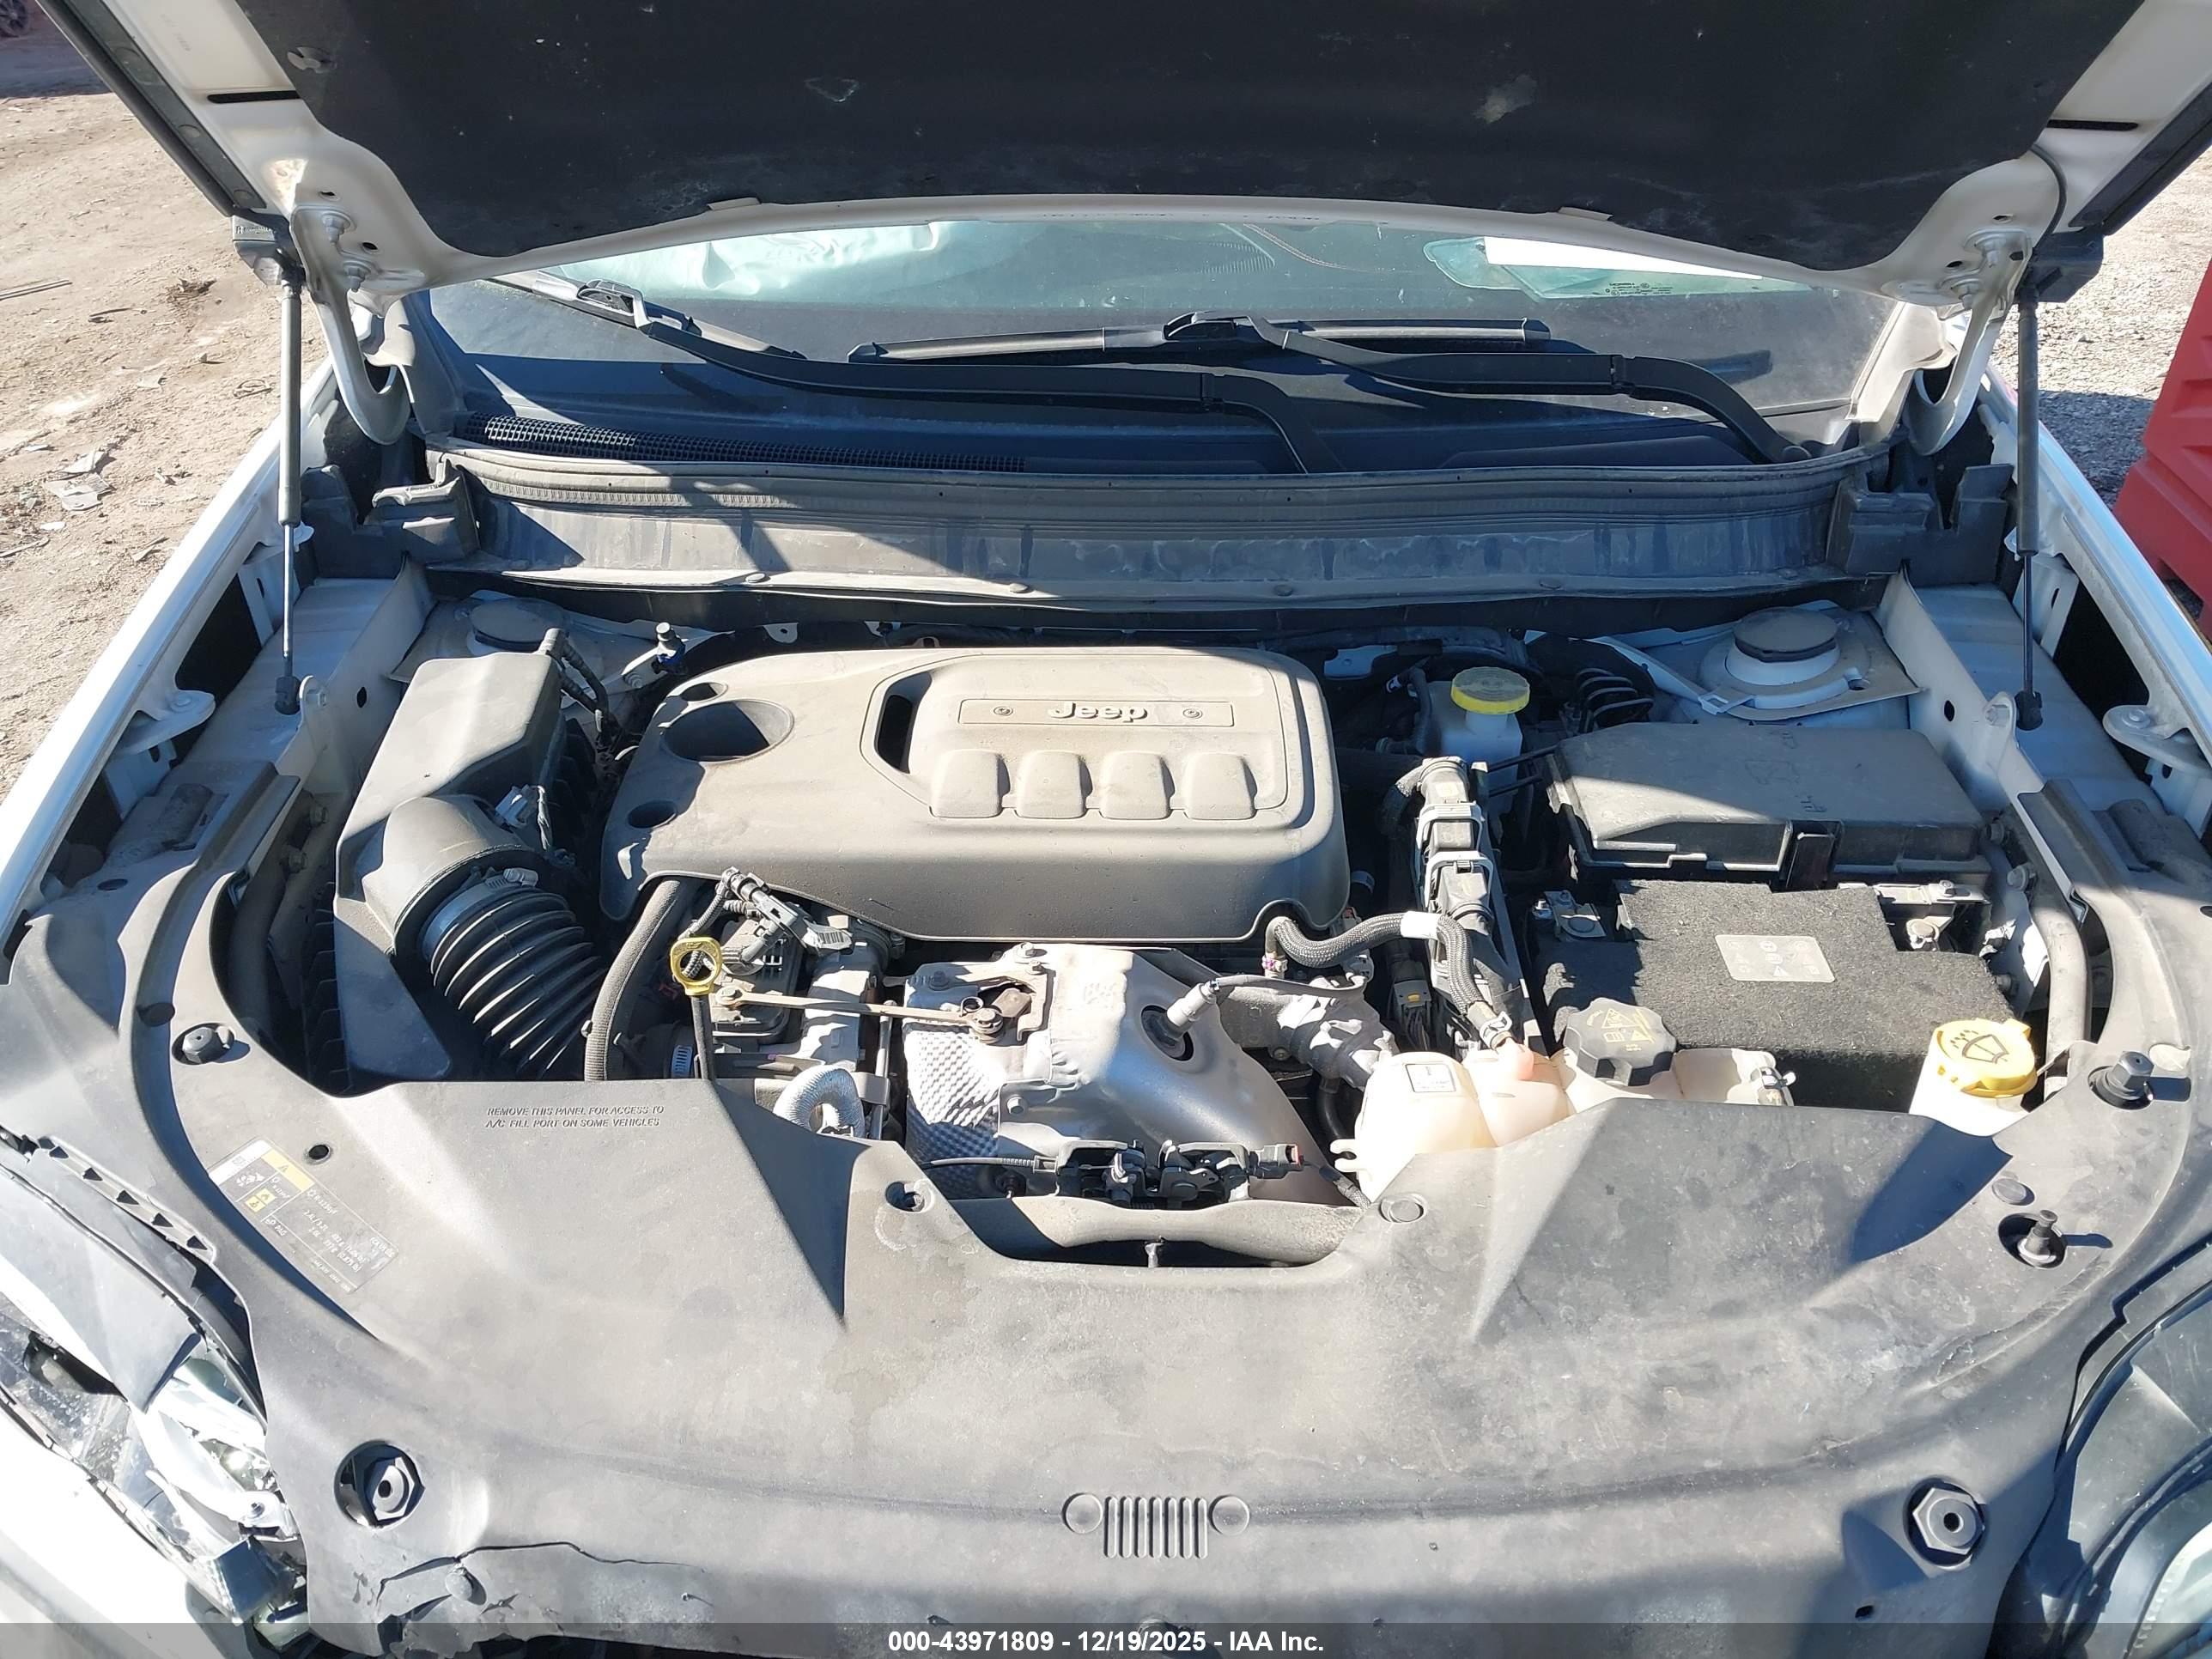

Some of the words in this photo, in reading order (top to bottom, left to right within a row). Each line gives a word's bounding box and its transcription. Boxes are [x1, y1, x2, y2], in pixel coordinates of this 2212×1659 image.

[1048, 702, 1148, 723] Jeep
[531, 1107, 552, 1115] THIS
[555, 1107, 586, 1115] PANEL
[610, 1106, 648, 1115] ACCESS
[485, 1119, 505, 1127] A/C
[533, 1119, 559, 1127] PORT
[562, 1119, 577, 1127] ON
[580, 1119, 609, 1127] SOME
[612, 1117, 659, 1127] VEHICLES
